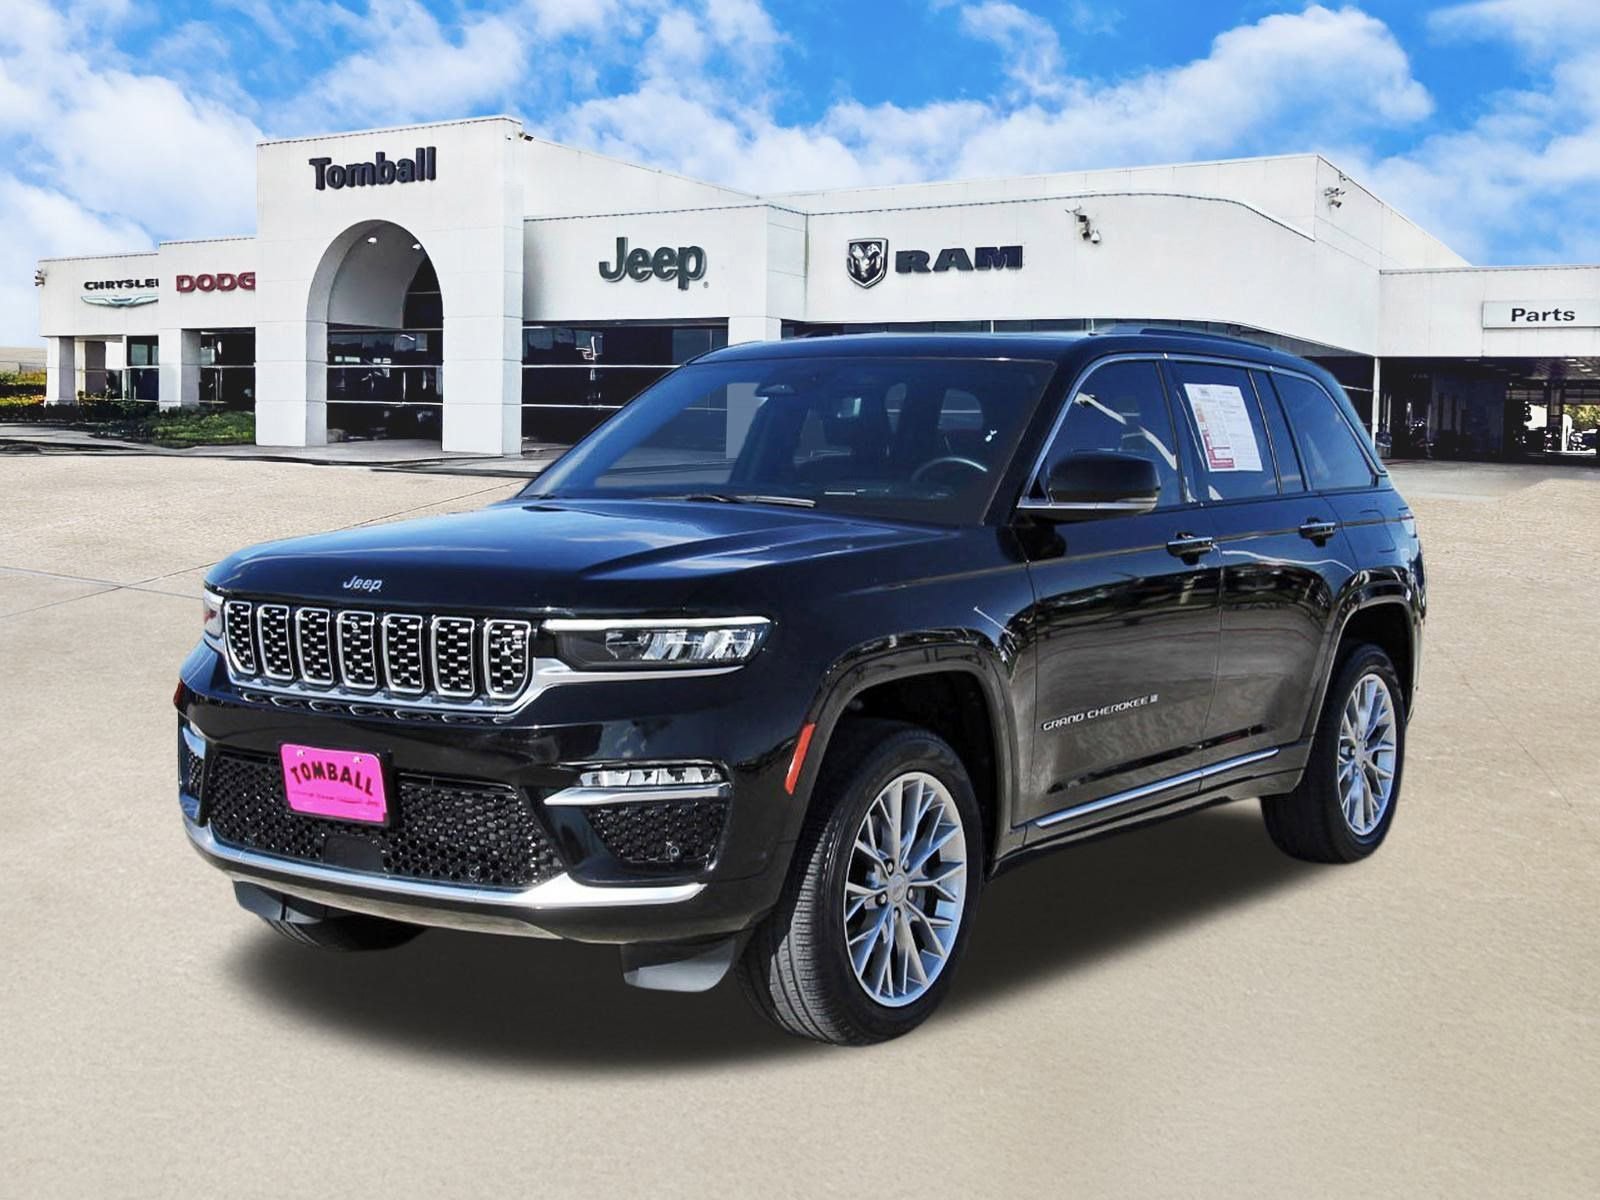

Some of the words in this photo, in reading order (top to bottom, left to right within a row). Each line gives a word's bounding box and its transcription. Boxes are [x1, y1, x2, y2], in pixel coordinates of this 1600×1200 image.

[309, 146, 436, 191] Tomball
[599, 236, 707, 290] Jeep
[896, 246, 1023, 273] RAM
[84, 278, 159, 290] CHRYSLE
[1511, 307, 1576, 322] Parts
[343, 576, 383, 592] Jeep
[1042, 713, 1085, 731] GRAND
[1087, 696, 1149, 719] CHEROKEE
[290, 761, 373, 796] TOMBALL
